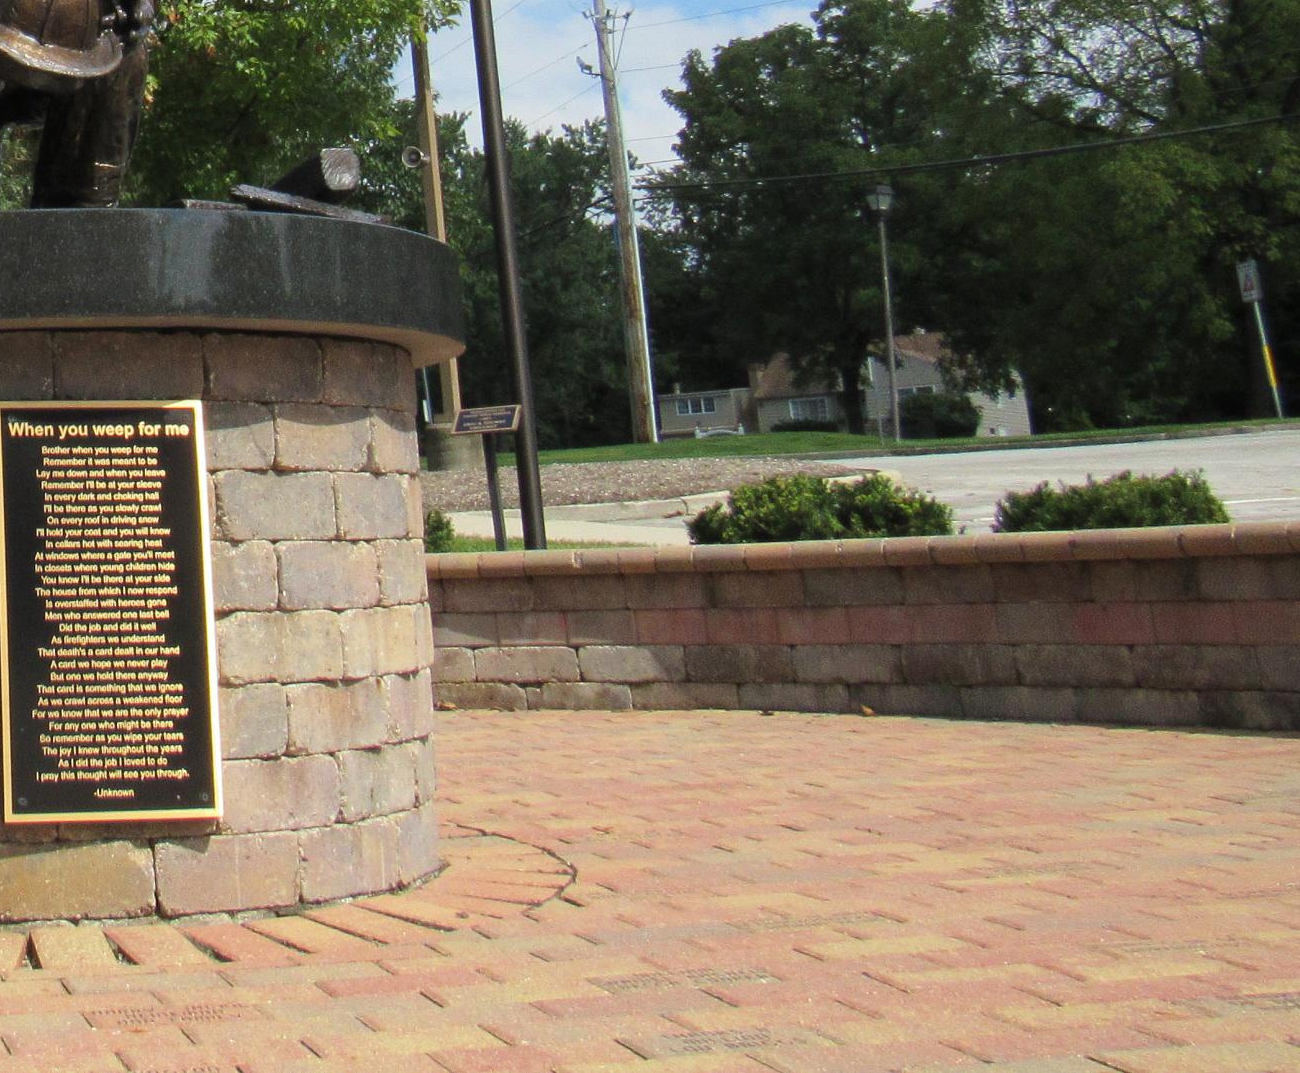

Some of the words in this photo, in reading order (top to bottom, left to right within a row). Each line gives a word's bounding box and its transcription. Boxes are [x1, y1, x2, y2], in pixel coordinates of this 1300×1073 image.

[8, 421, 54, 436] When
[58, 424, 88, 439] you
[92, 424, 135, 439] weep
[138, 421, 162, 436] for
[165, 424, 190, 436] me
[41, 445, 71, 454] Brother
[71, 446, 93, 454] when
[94, 447, 109, 455] you
[110, 447, 132, 455] weep
[133, 445, 144, 453] for
[43, 457, 87, 466] Remember
[87, 457, 93, 465] it
[111, 457, 137, 465] meant
[137, 457, 146, 465] to
[147, 457, 158, 465] be
[36, 469, 51, 479] Lay
[66, 469, 88, 477] down
[89, 469, 105, 477] and
[105, 468, 127, 477] when
[128, 470, 144, 478] you
[144, 468, 166, 477] leave
[41, 481, 85, 489] Remember
[95, 480, 107, 488] be
[117, 481, 135, 490] your
[136, 480, 162, 488] sleeve
[45, 493, 52, 501] In
[54, 494, 77, 502] every
[77, 492, 95, 500] dark
[96, 492, 112, 500] and
[113, 491, 144, 502] choking
[144, 491, 160, 500] hall
[53, 504, 64, 512] be
[65, 504, 86, 512] there
[99, 505, 114, 513] you
[115, 503, 140, 513] slowly
[140, 503, 162, 512] crawl
[47, 516, 59, 524] On
[60, 517, 83, 526] every
[84, 515, 100, 524] roof
[101, 515, 109, 524] in
[110, 515, 137, 525] driving
[138, 516, 159, 524] snow
[45, 540, 53, 548] In
[82, 539, 95, 547] hot
[96, 539, 113, 547] with
[144, 538, 163, 547] heat
[35, 564, 43, 572] In
[73, 563, 98, 572] where
[99, 564, 124, 573] young
[125, 562, 157, 571] children
[157, 562, 176, 571] hide
[41, 575, 57, 584] You
[58, 575, 80, 584] know
[91, 575, 102, 583] be
[103, 575, 124, 583] there
[125, 575, 133, 583] at
[134, 576, 153, 584] your
[153, 573, 171, 582] side
[46, 599, 53, 608] Is
[100, 599, 117, 607] with
[118, 598, 146, 607] heroes
[146, 599, 167, 608] gone
[45, 611, 63, 620] Men
[64, 611, 81, 620] who
[82, 610, 121, 619] answered
[122, 611, 138, 619] one
[139, 610, 154, 619] last
[155, 609, 170, 618] bell
[59, 623, 73, 632] Did
[74, 623, 87, 631] the
[88, 623, 102, 633] job
[103, 622, 119, 631] and
[119, 622, 133, 631] did
[134, 622, 139, 631] it
[140, 622, 157, 630] well
[51, 635, 62, 644] As
[64, 634, 106, 645] firefighters
[121, 634, 166, 643] understand
[50, 660, 57, 669] A
[58, 659, 76, 669] card
[91, 659, 112, 670] hope
[113, 660, 125, 668] we
[50, 671, 64, 681] But
[66, 673, 81, 681] one
[96, 671, 114, 680] hold
[115, 671, 137, 680] there
[137, 671, 169, 681] anyway
[37, 697, 49, 706] As
[50, 698, 63, 706] we
[64, 696, 86, 705] crawl
[87, 697, 114, 705] across
[164, 694, 183, 703] floor
[49, 721, 63, 730] For
[64, 722, 80, 731] any
[98, 720, 115, 729] who
[116, 720, 139, 730] might
[140, 719, 151, 728] be
[152, 719, 174, 728] there
[53, 733, 94, 743] remember
[95, 734, 106, 742] as
[107, 734, 122, 743] you
[123, 732, 143, 743] wipe
[144, 733, 163, 742] your
[163, 732, 184, 740] tears
[58, 758, 69, 767] As
[71, 758, 74, 767] I
[75, 758, 89, 767] did
[90, 758, 103, 767] the
[104, 757, 118, 768] job
[119, 757, 122, 766] I
[124, 756, 146, 766] loved
[147, 756, 156, 765] to
[157, 756, 168, 765] do
[36, 772, 39, 780] I
[41, 773, 59, 782] pray
[61, 770, 75, 780] this
[77, 770, 108, 781] thought
[108, 770, 122, 779] will
[140, 770, 156, 779] you
